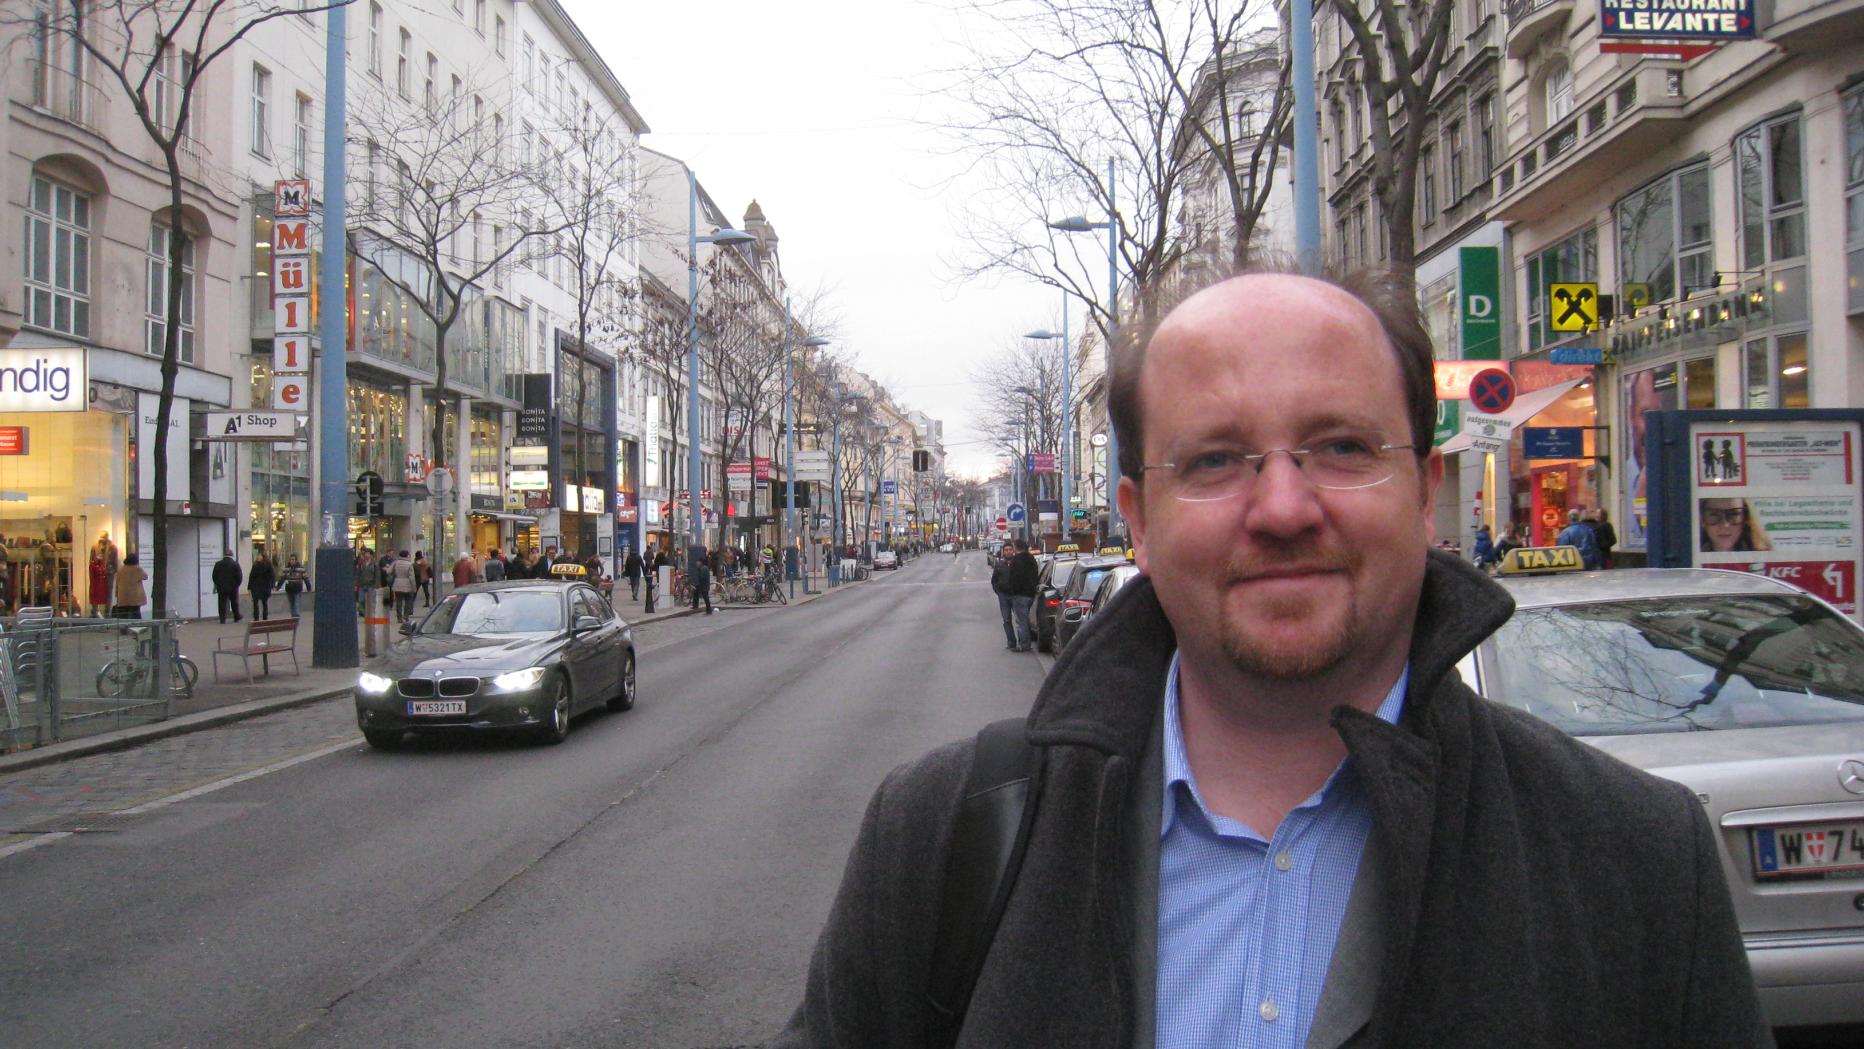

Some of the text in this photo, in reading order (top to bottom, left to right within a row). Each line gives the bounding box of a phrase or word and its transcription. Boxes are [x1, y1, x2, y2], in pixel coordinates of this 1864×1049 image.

[1618, 12, 1737, 32] LEVANTE
[284, 190, 299, 205] M
[1468, 295, 1492, 317] D
[521, 407, 546, 415] BONITA
[224, 415, 277, 434] A1 Shop
[521, 415, 546, 424] BONITA
[521, 424, 546, 433] BONITA
[1472, 439, 1501, 452] Anfang
[1102, 547, 1122, 555] TAXI
[1519, 548, 1576, 569] TAXI
[555, 565, 579, 574] TAXI
[1769, 566, 1802, 578] KFC
[415, 703, 422, 713] W
[1781, 829, 1864, 865] W 74
